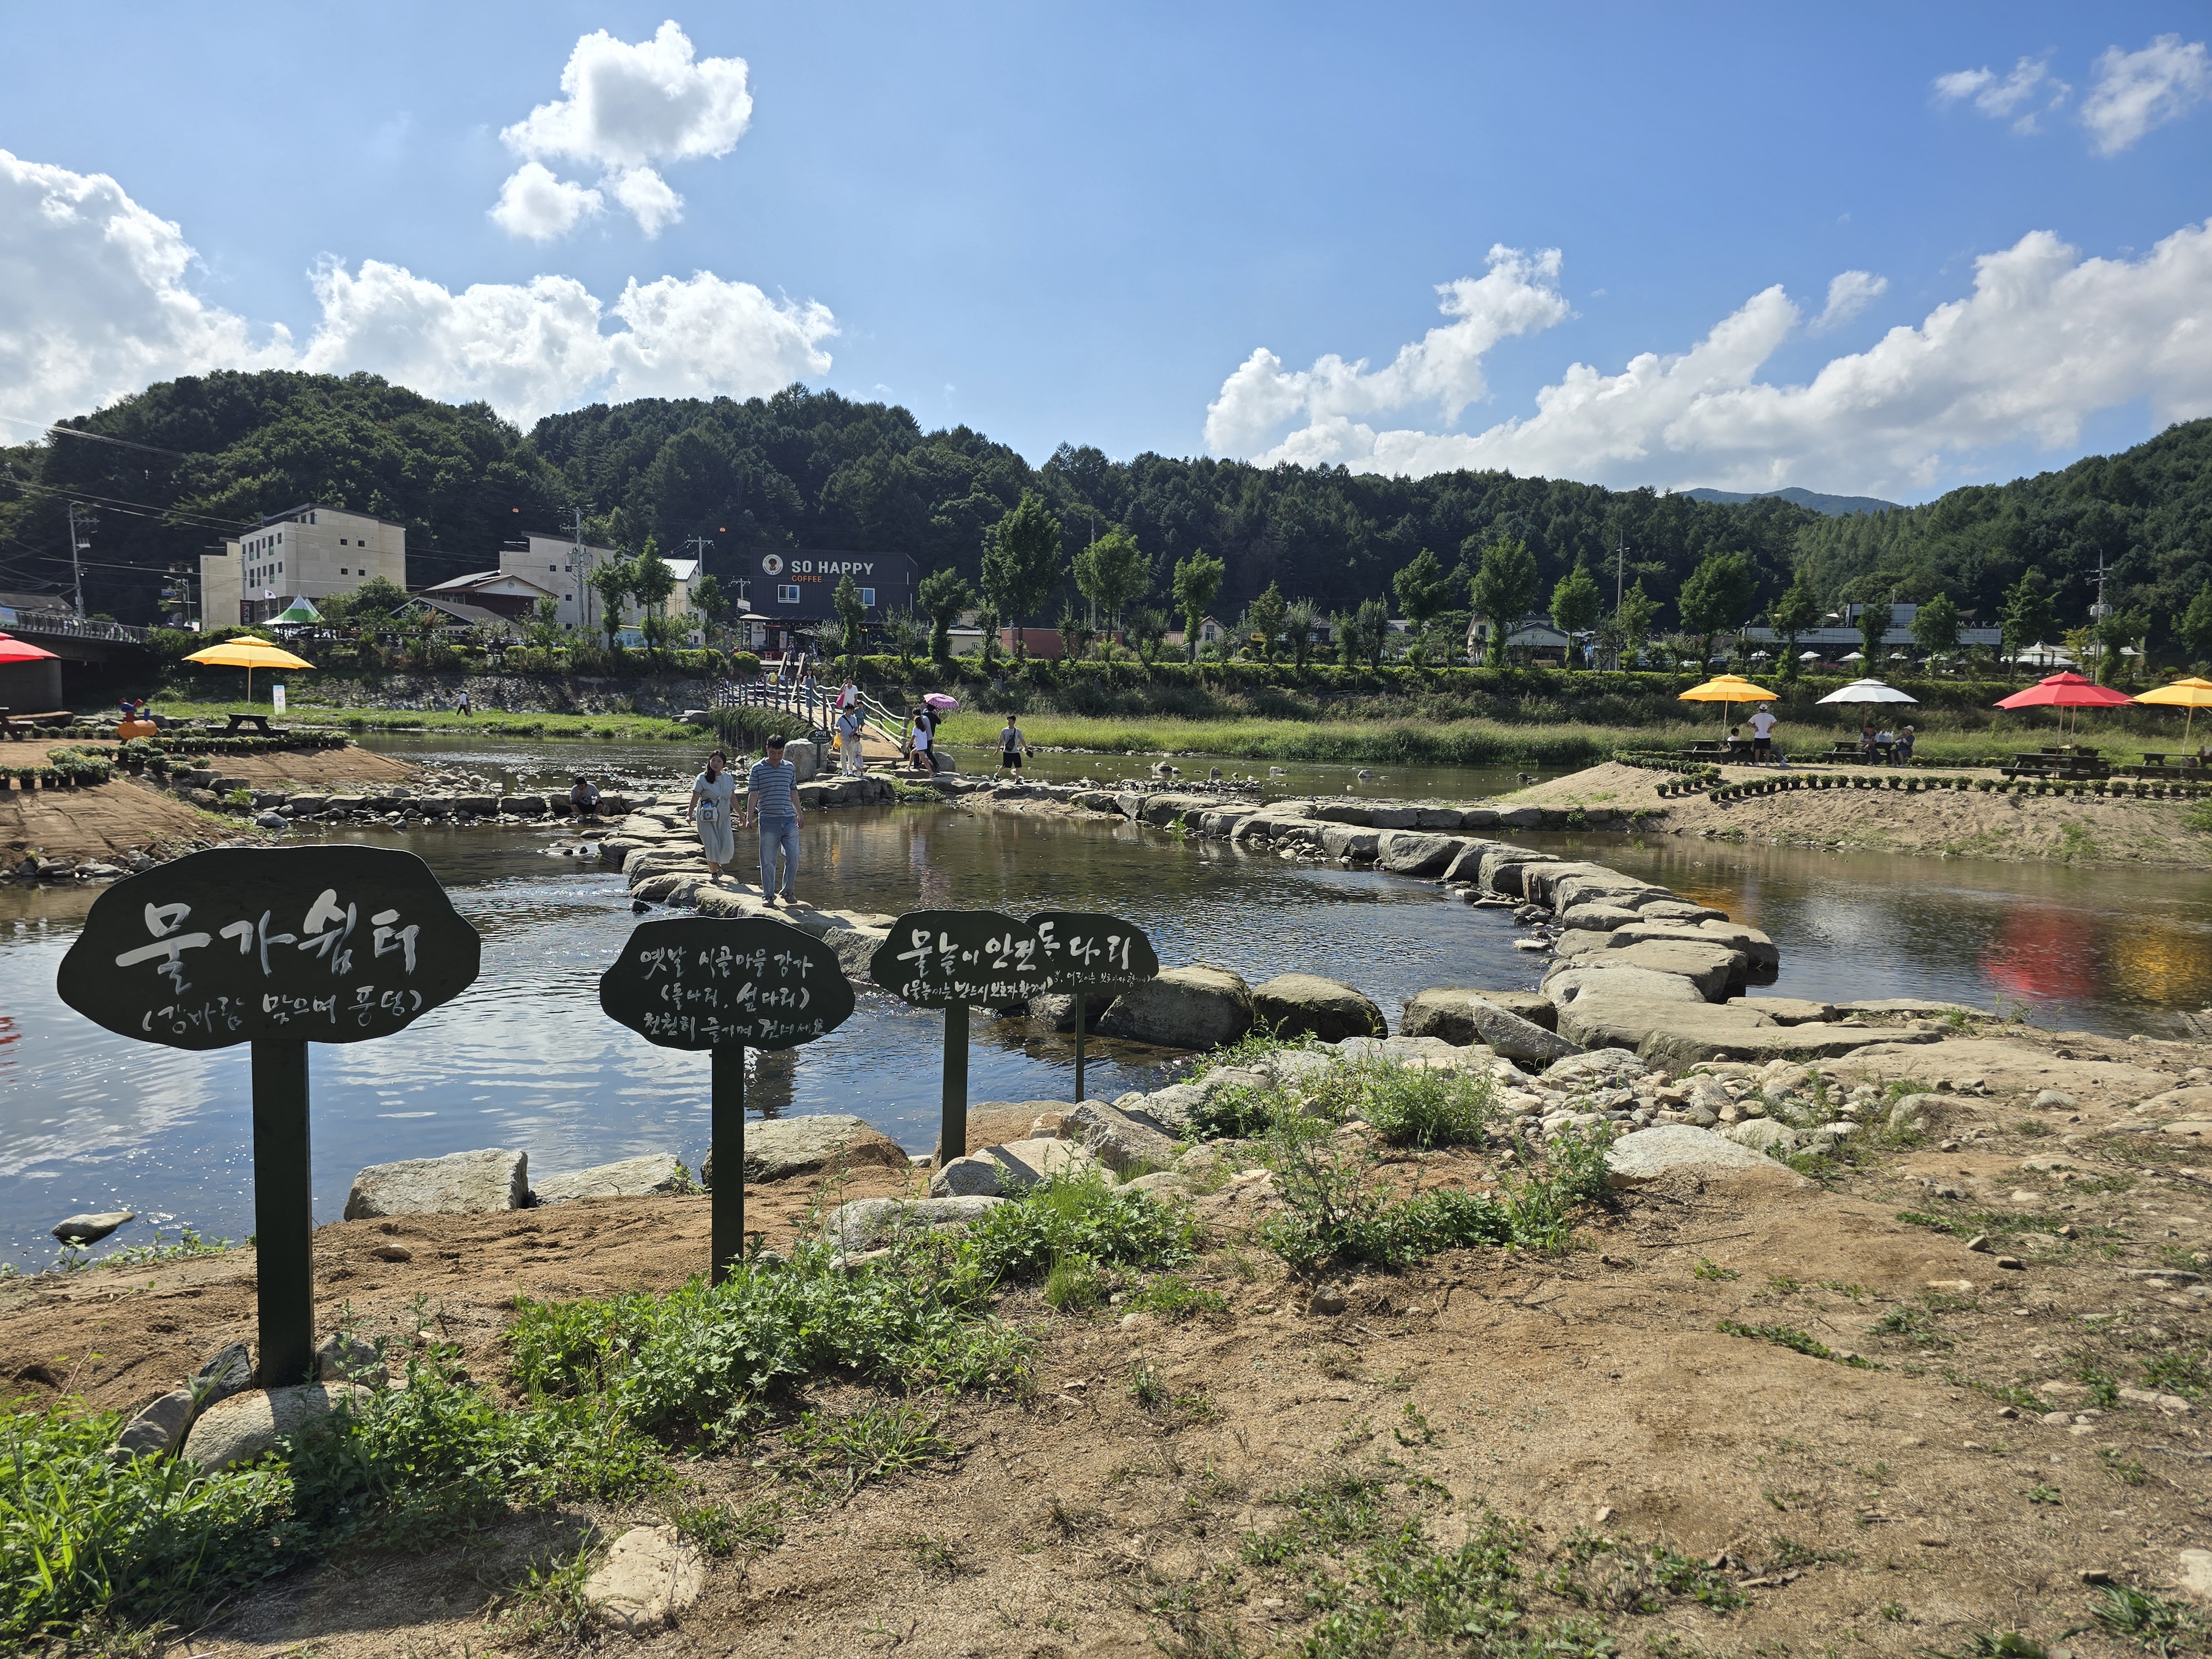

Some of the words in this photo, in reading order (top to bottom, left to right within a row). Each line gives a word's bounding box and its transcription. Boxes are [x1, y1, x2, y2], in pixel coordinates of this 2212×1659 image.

[791, 560, 812, 573] SO
[818, 561, 874, 575] HAPPY
[791, 575, 822, 583] COFFEE
[640, 946, 687, 980] 옛날
[698, 945, 767, 979] 시골마을
[773, 950, 814, 979] 강가
[896, 928, 979, 979] 물놀이
[985, 932, 1037, 972] 안전
[954, 981, 989, 1003] 반드시
[1067, 971, 1096, 987] 어린이는
[142, 997, 244, 1034] (강바람
[262, 994, 336, 1025] 맞으며
[348, 986, 422, 1026] 풍덩)
[644, 1012, 696, 1042] 천천히
[700, 1016, 753, 1044] 즐기며
[758, 1018, 826, 1039] 건너세요
